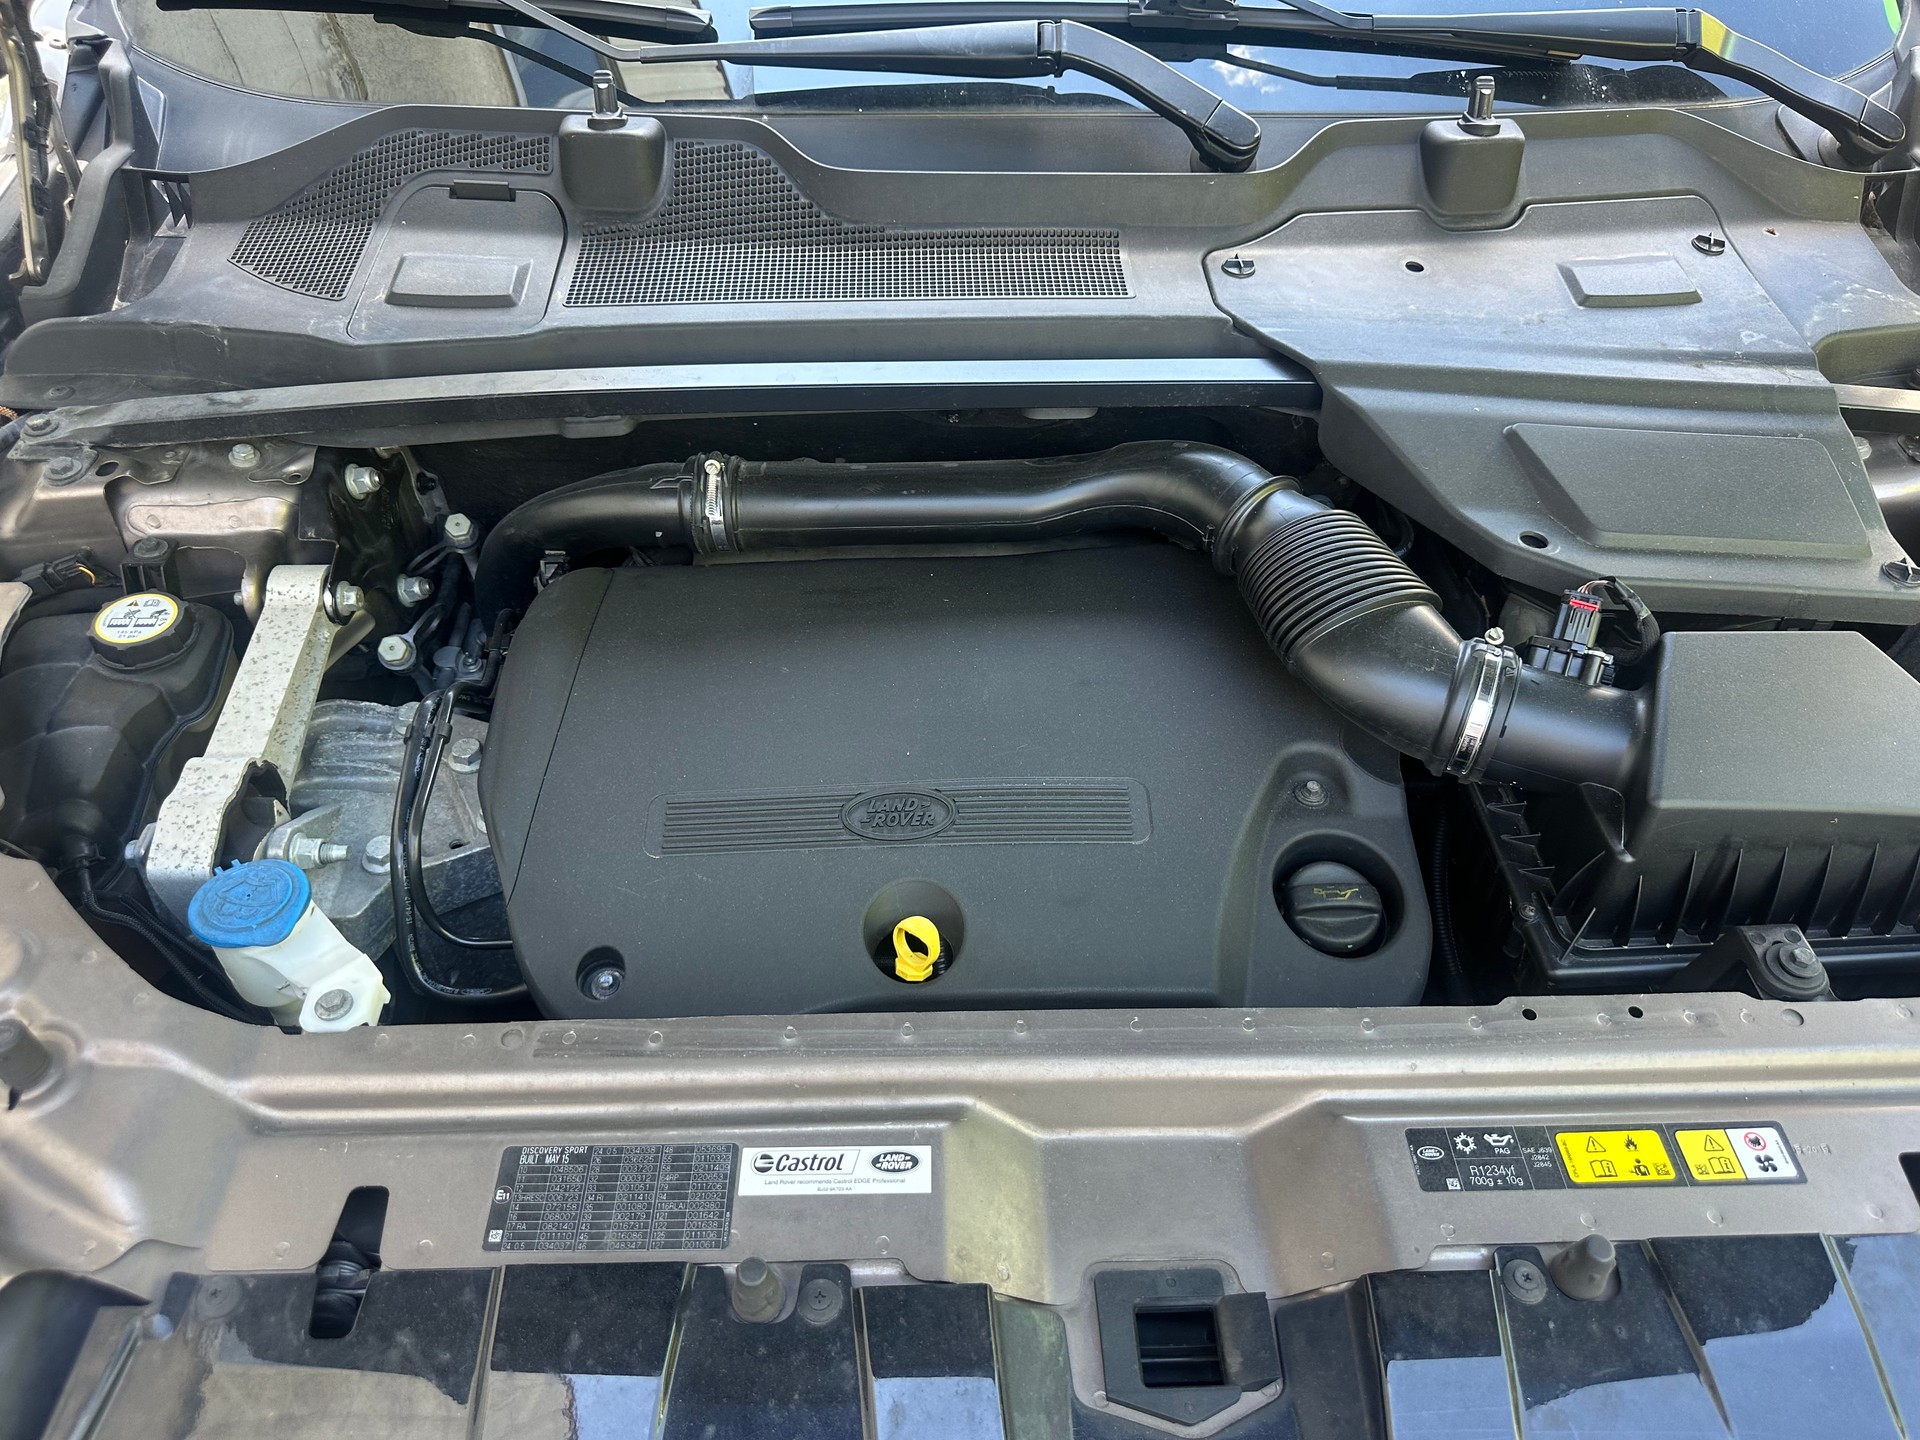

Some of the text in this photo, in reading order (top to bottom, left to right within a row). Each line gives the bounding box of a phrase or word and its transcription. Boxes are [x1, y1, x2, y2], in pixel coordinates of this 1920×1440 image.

[867, 799, 918, 812] LAND
[872, 812, 935, 827] ROVER
[564, 1146, 588, 1154] SPORT
[624, 1146, 656, 1154] 034038
[520, 1154, 570, 1164] BUILT MAY 15
[695, 1154, 731, 1162] 0110322
[879, 1154, 905, 1162] LAND
[775, 1153, 845, 1172] Castrol
[880, 1161, 914, 1170] ROVER
[621, 1165, 654, 1173] 003720
[1469, 1165, 1516, 1177] R1234yf
[1469, 1176, 1494, 1186] 700g
[1506, 1176, 1524, 1186] 10g
[689, 1201, 721, 1209] 002980
[614, 1212, 646, 1220] 002179
[687, 1211, 720, 1219] 001642
[613, 1222, 644, 1230] 016731
[686, 1221, 719, 1229] 001638
[540, 1232, 572, 1240] 011110
[538, 1242, 570, 1250] 034037
